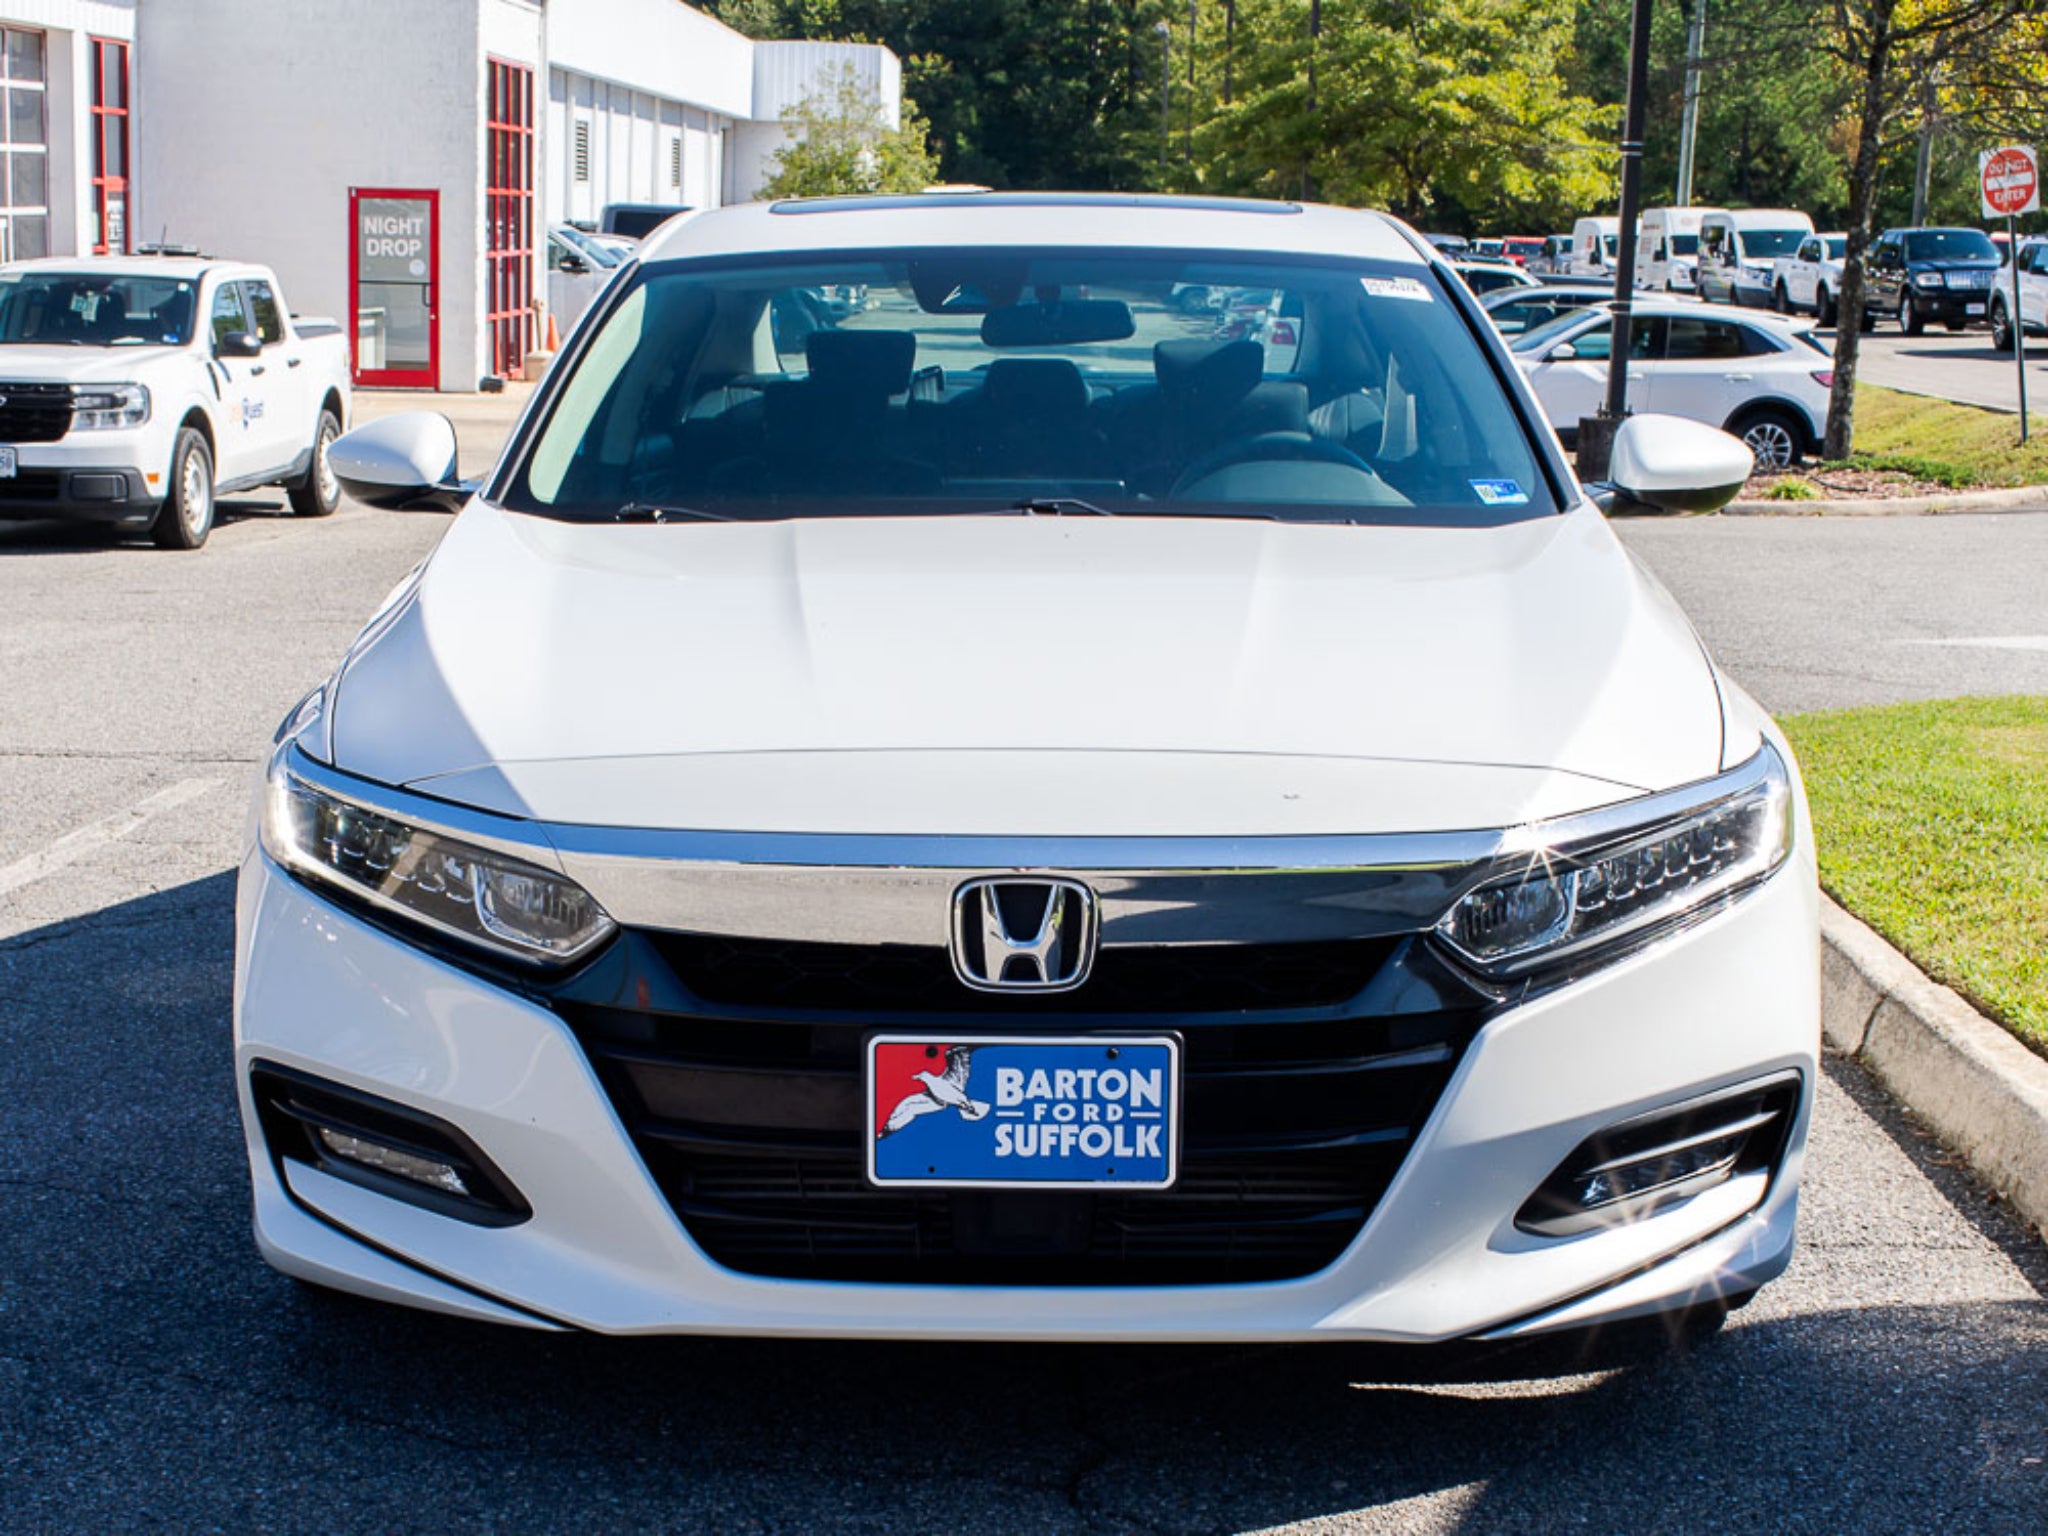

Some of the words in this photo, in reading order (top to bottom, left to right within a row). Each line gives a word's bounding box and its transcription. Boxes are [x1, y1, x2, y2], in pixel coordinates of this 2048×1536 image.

[364, 216, 424, 235] NIGHT
[366, 238, 422, 257] DROP
[997, 1068, 1162, 1107] BARTON
[1033, 1103, 1124, 1122] FORD
[994, 1124, 1162, 1158] SUFFOLK
